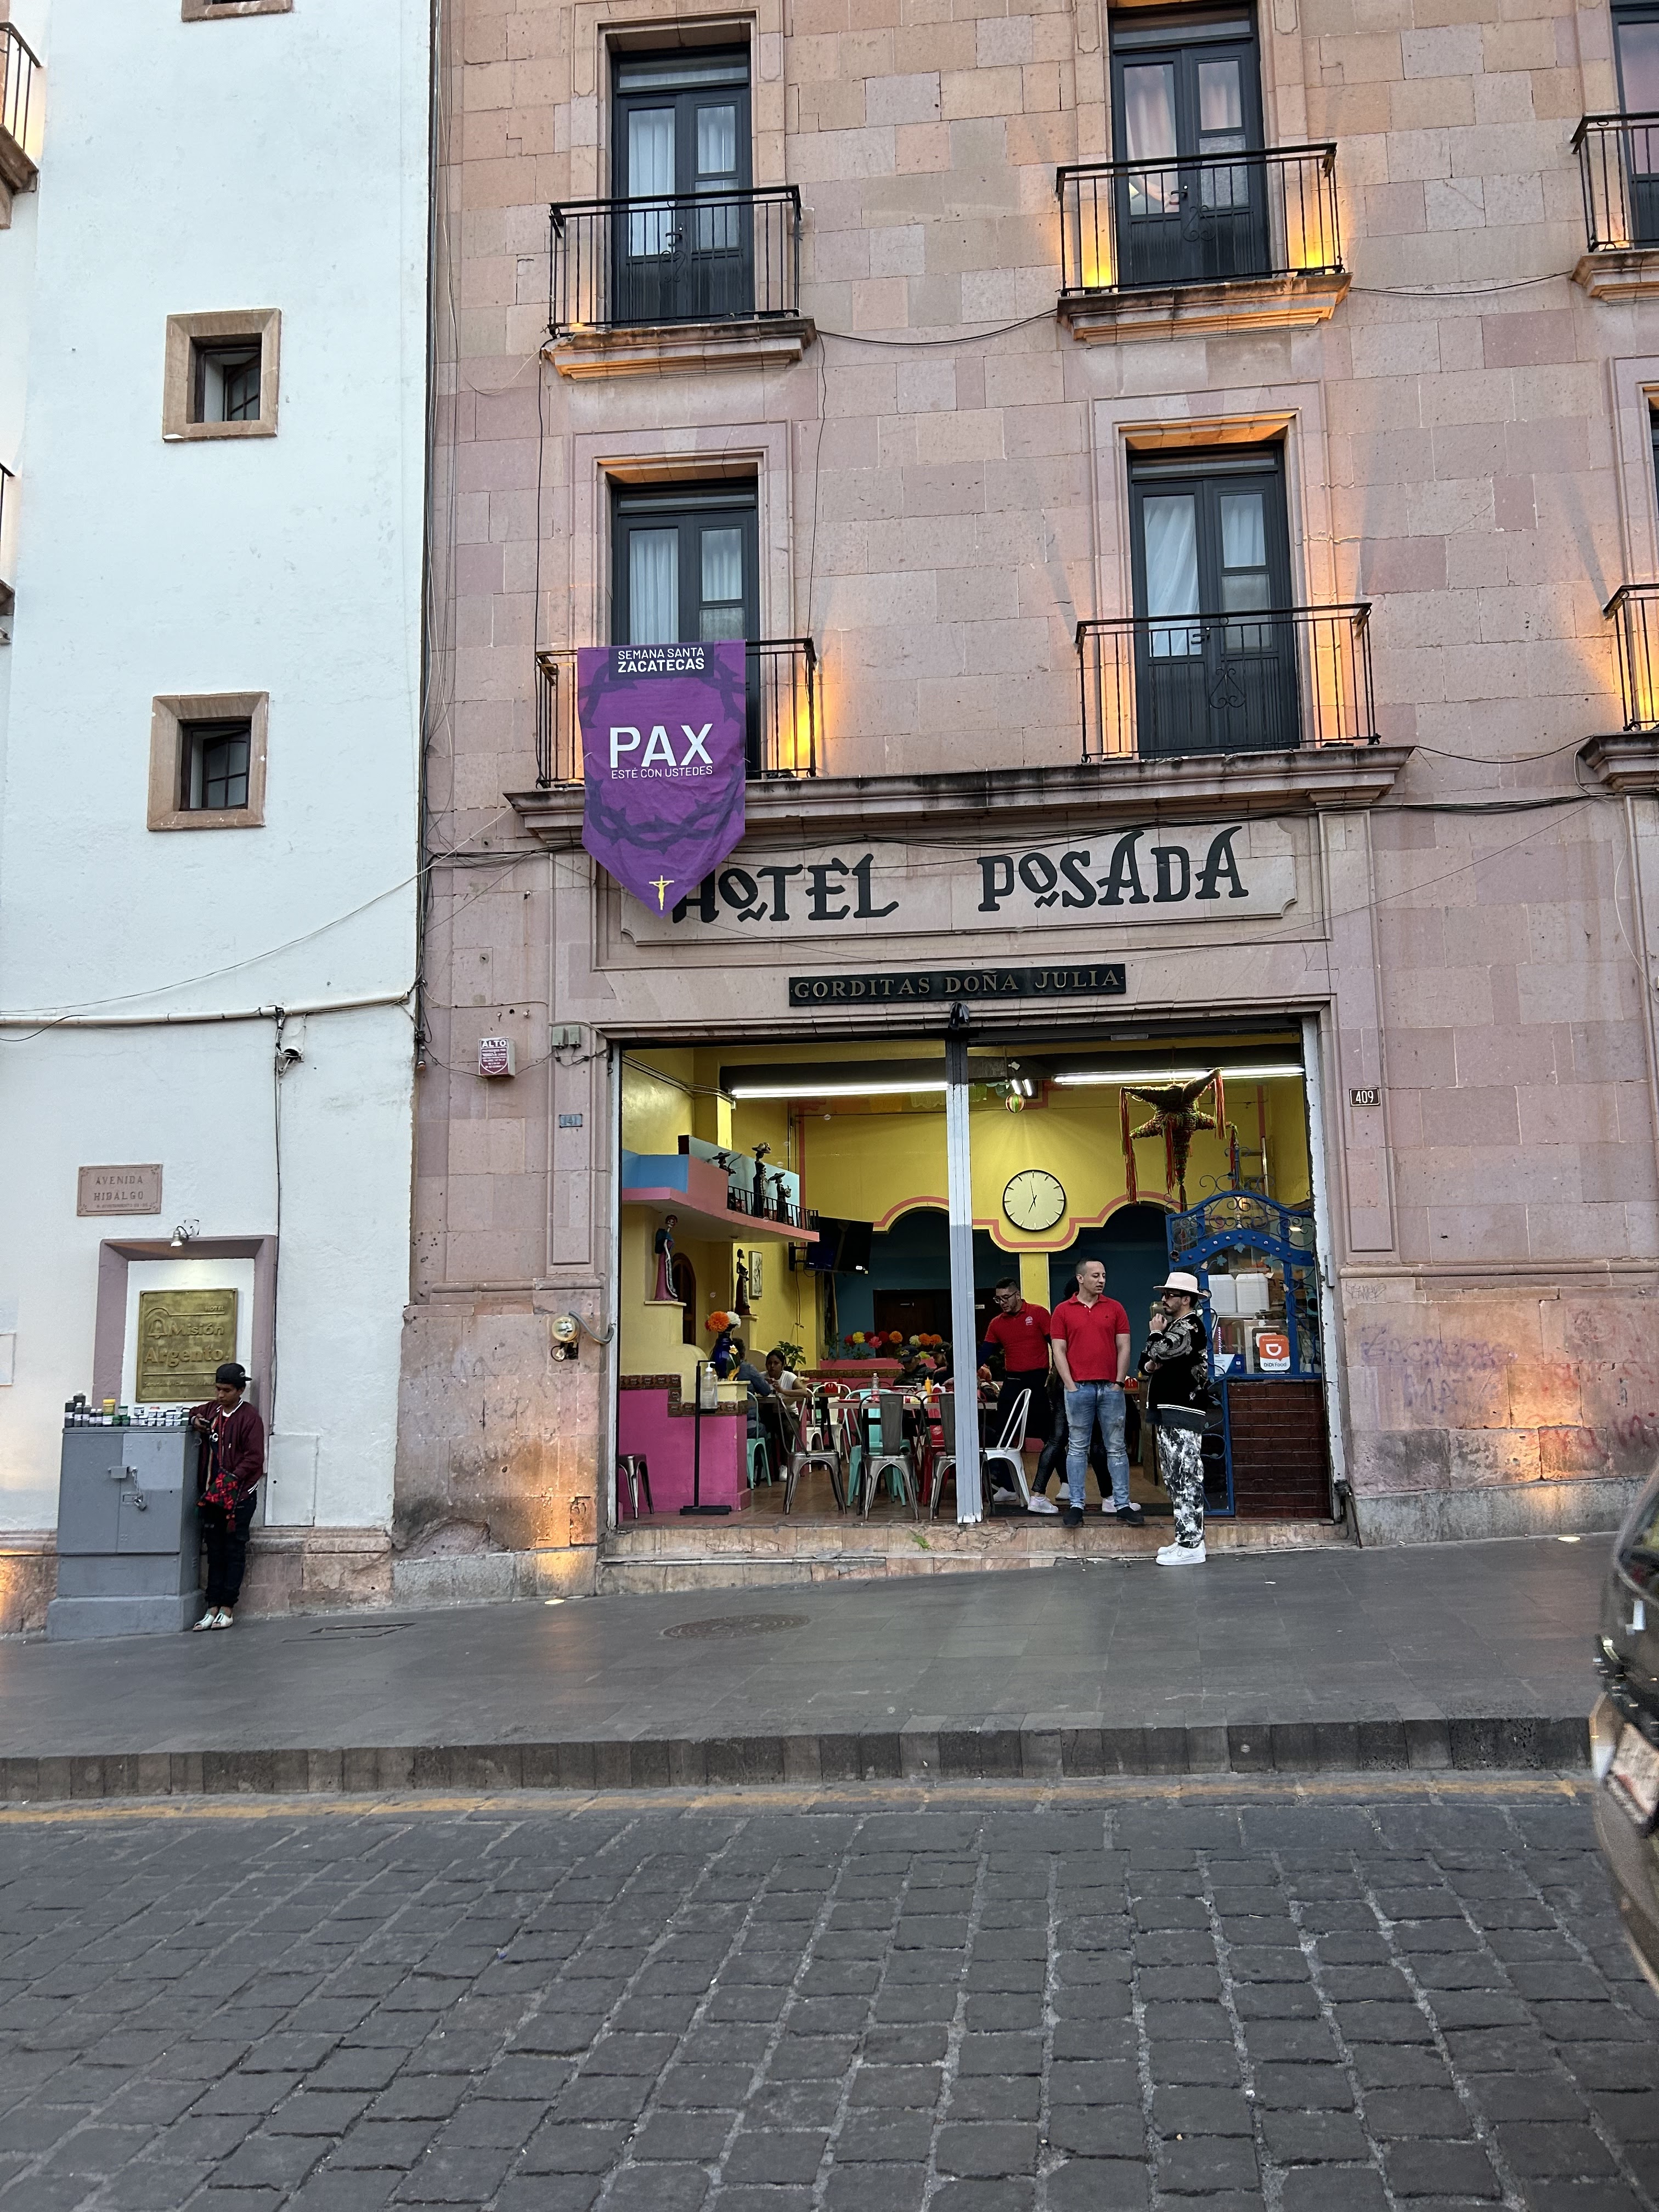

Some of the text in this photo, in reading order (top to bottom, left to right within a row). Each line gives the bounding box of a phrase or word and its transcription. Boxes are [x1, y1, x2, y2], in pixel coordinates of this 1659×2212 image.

[618, 647, 705, 660] SEMANA SANTA
[618, 658, 705, 673] ZACATECAS
[610, 723, 713, 769] PAX
[611, 765, 713, 780] ESTÉ CON USTEDES
[977, 826, 1249, 912] POSADA
[794, 970, 1120, 998] GORDITAS DOÑA JULIA
[482, 1040, 506, 1048] ALTO
[1356, 1090, 1374, 1103] 409
[95, 1176, 144, 1186] AVENIDA
[94, 1191, 144, 1201] HIDALGO
[169, 1321, 224, 1336] Misión
